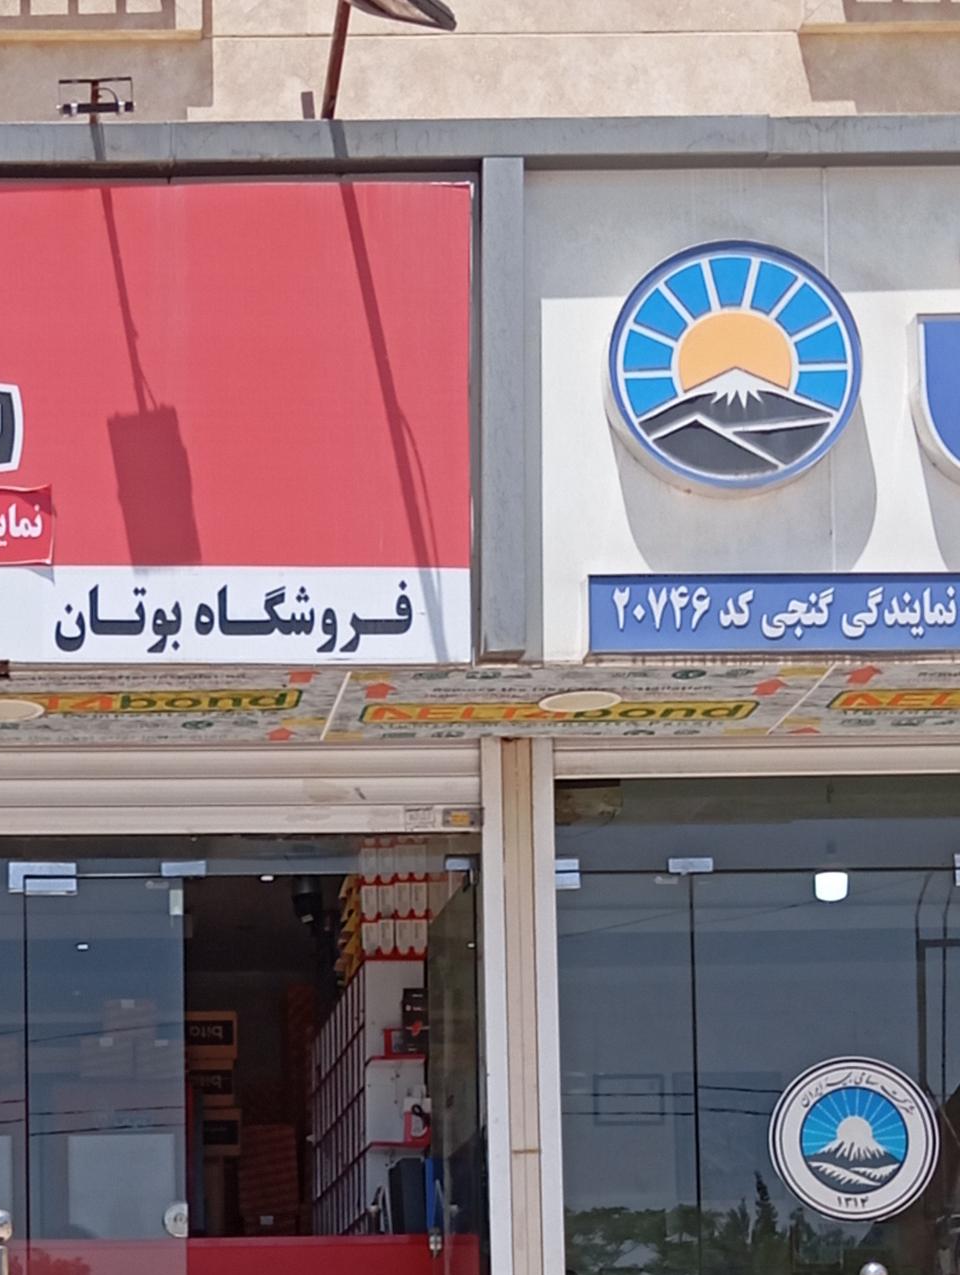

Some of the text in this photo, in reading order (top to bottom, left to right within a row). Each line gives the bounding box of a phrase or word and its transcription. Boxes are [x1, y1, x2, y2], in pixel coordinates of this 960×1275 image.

[55, 580, 413, 653] فروشگاه بوتان
[613, 585, 957, 637] نمایندگی گنجی کد ۲۰۷۴۶
